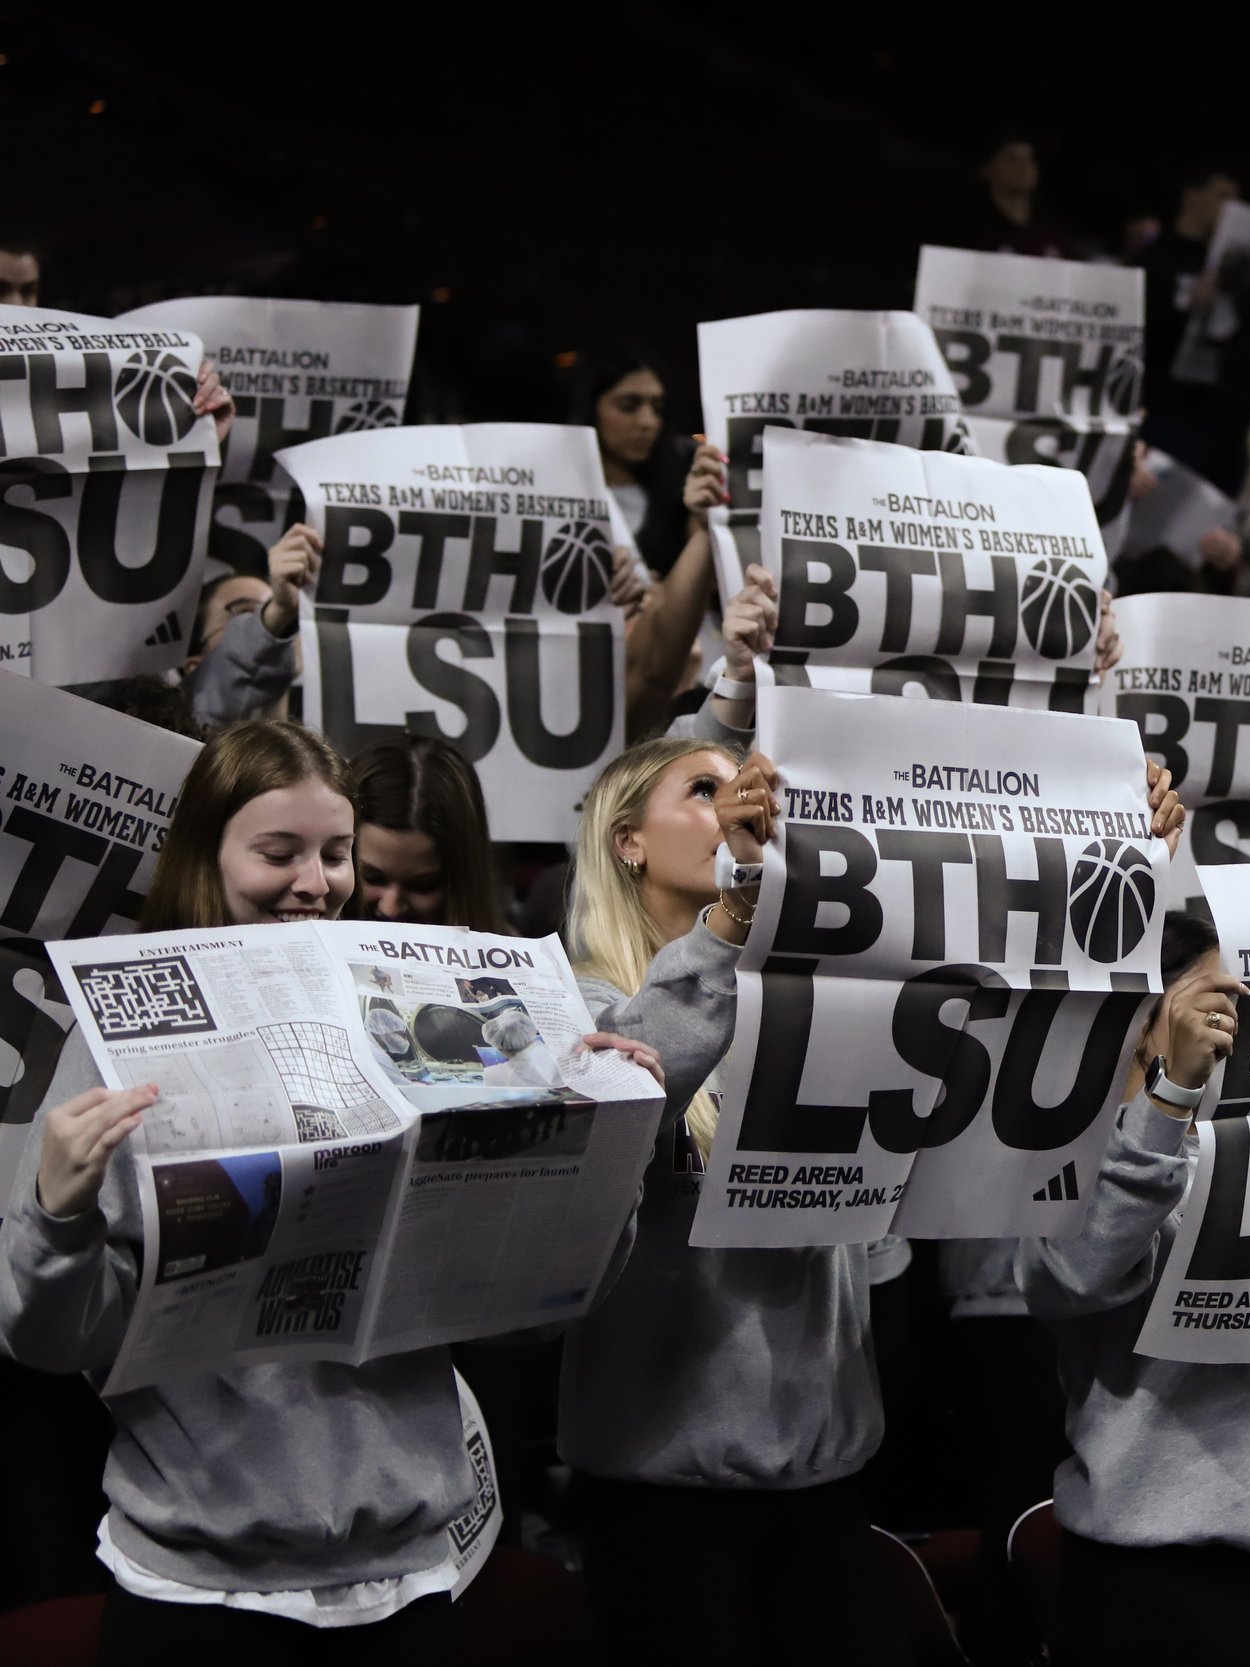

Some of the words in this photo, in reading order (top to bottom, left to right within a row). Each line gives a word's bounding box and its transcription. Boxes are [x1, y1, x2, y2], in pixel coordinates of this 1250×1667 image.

[66, 333, 190, 351] BASKETBALL
[220, 347, 329, 369] BATTALION
[843, 369, 935, 389] BATTALION
[725, 393, 790, 415] TEXAS
[797, 393, 834, 415] A&M
[839, 394, 915, 416] WOMEN'S
[427, 465, 534, 487] BATTALION
[320, 482, 382, 505] TEXAS
[389, 485, 425, 509] A&M
[433, 489, 510, 514] WOMEN'S
[516, 493, 611, 521] BASKETBALL
[888, 493, 996, 523] BATTALION
[780, 510, 838, 539] TEXAS
[846, 517, 884, 542] A&M
[890, 520, 974, 551] WOMEN'S
[979, 525, 1095, 559] BASKETBALL
[315, 607, 615, 771] LSU
[1114, 667, 1182, 692] TEXAS
[1186, 670, 1223, 693] A&M
[60, 763, 77, 778] THE
[893, 771, 910, 783] THE
[911, 764, 1040, 798] BATTALION
[7, 773, 62, 814] A&M
[64, 793, 170, 853] WOMEN'S
[784, 788, 854, 823] TEXAS
[862, 797, 908, 826] A&M
[911, 800, 1015, 832] WOMEN'S
[1022, 806, 1155, 841] BASKETBALL
[139, 939, 245, 958] ENTERTAINMENT
[359, 943, 379, 953] THE
[378, 940, 535, 970] BATTALION
[107, 1043, 148, 1062] Spring
[148, 1039, 200, 1053] semester
[202, 1028, 257, 1048] struggles
[735, 955, 1150, 1154] LSU
[314, 1142, 383, 1162] maroon
[314, 1156, 339, 1171] life
[464, 1168, 518, 1185] prepares
[520, 1166, 537, 1178] for
[539, 1164, 580, 1178] launch
[727, 1164, 790, 1185] REED
[793, 1166, 864, 1185] ARENA
[726, 1188, 842, 1212] THURSDAY,
[845, 1187, 887, 1208] JAN.
[1174, 1289, 1233, 1310] REED
